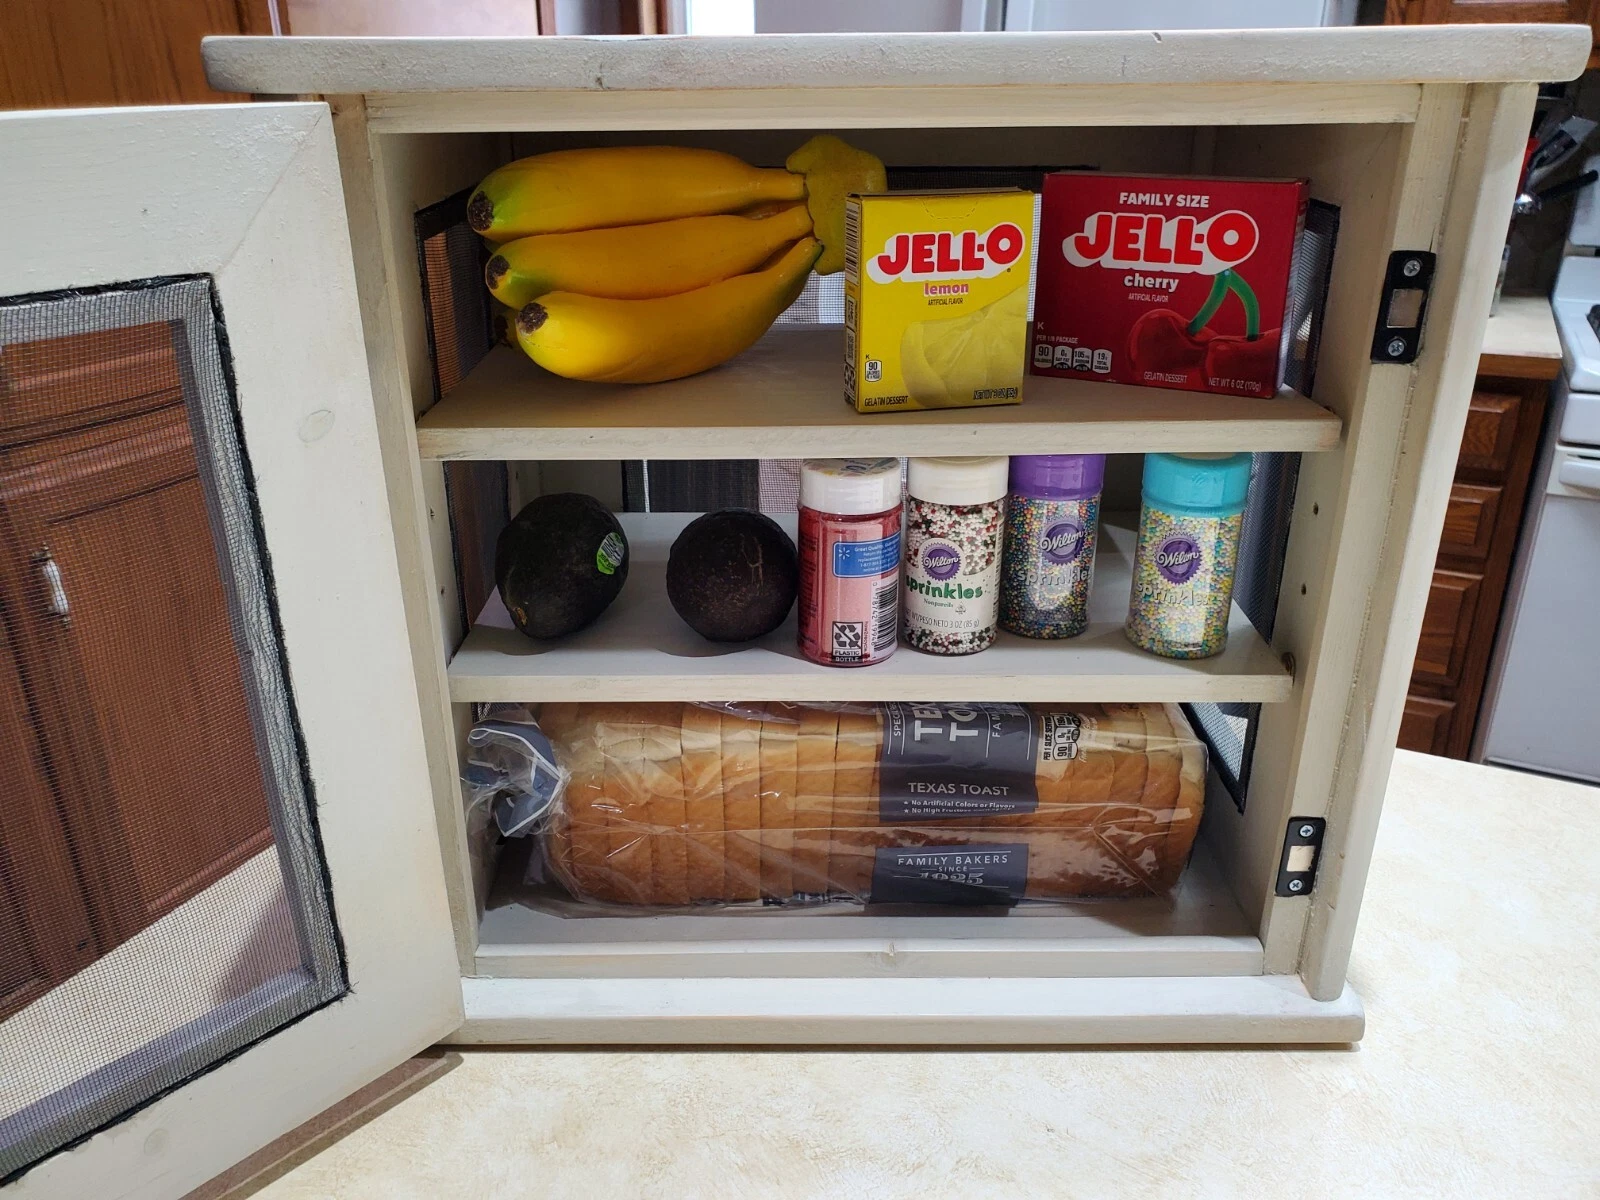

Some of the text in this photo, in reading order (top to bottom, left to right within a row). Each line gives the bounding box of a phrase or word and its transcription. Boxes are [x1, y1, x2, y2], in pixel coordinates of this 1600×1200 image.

[1119, 192, 1210, 208] FAMILY SIZE
[1068, 211, 1258, 270] JELL-O
[872, 222, 1025, 279] JELL-O
[924, 282, 969, 296] lemon
[1123, 273, 1179, 293] cherry
[1128, 293, 1169, 303] ARTIFICIAL FLAVOR
[1037, 322, 1044, 330] K
[1038, 346, 1050, 356] 90
[868, 362, 878, 370] 90
[1144, 372, 1188, 384] GELATIN DESSERT
[1208, 377, 1220, 386] NET
[1220, 378, 1230, 388] WT
[1236, 380, 1244, 388] OZ
[1244, 380, 1262, 392] (170g)
[864, 396, 908, 406] GELATIN DESSERT
[1040, 529, 1085, 552] Wilton
[924, 553, 960, 569] Wilton
[1156, 551, 1200, 568] Wilton
[934, 619, 948, 628] NETO
[954, 621, 962, 629] OZ
[1058, 746, 1068, 757] 90
[908, 782, 1009, 796] TEXAS TOAST
[898, 855, 1008, 866] FAMILY BAKERS
